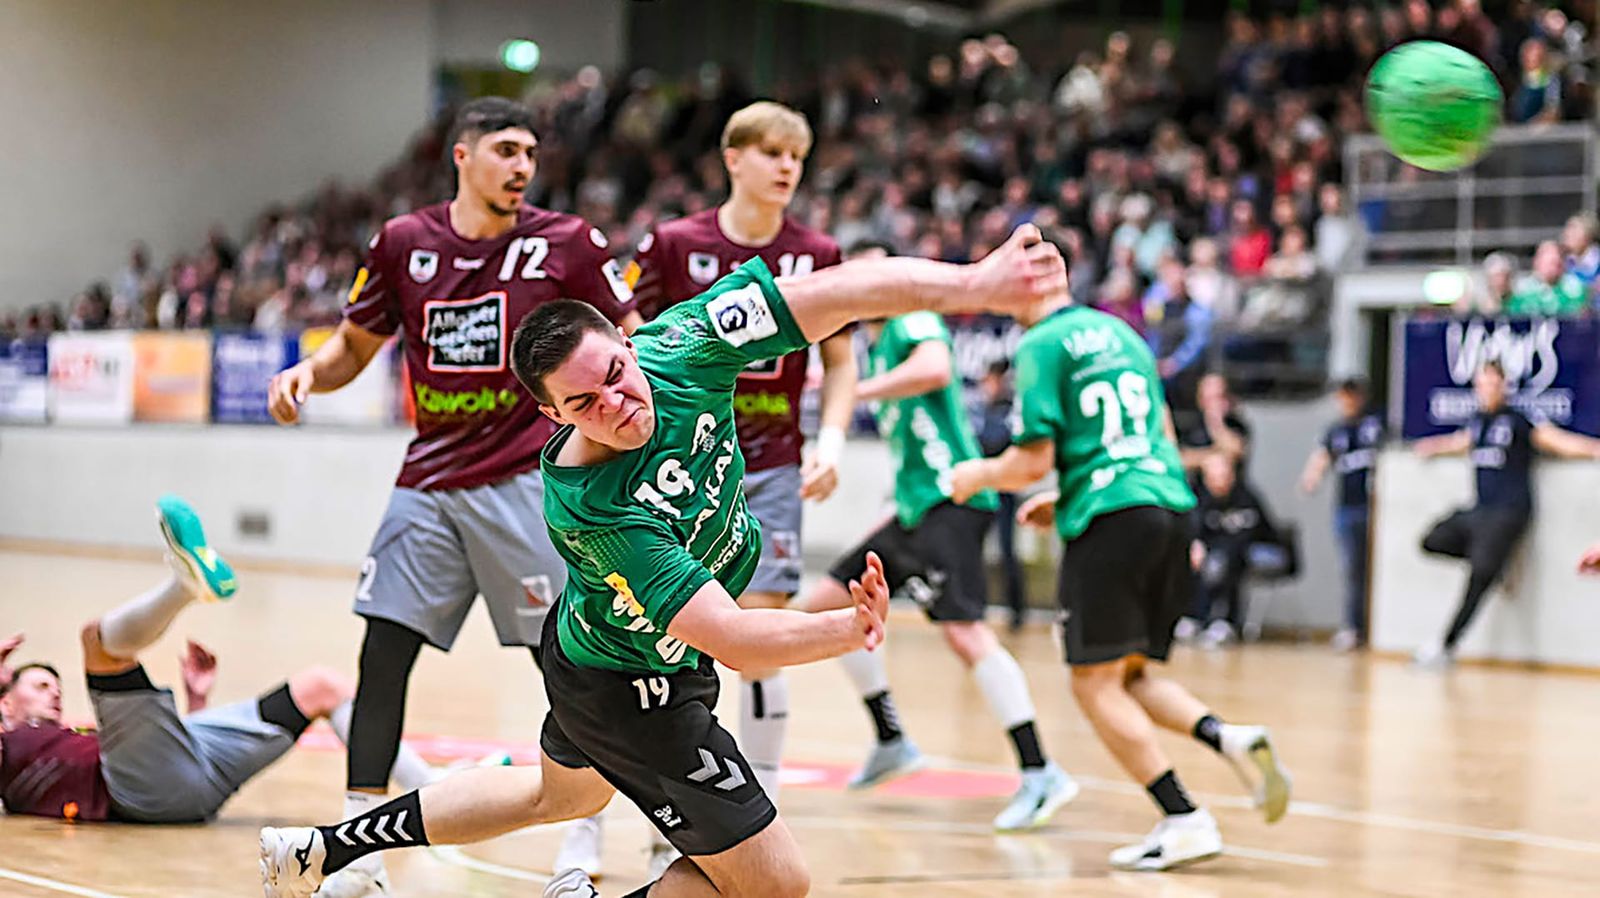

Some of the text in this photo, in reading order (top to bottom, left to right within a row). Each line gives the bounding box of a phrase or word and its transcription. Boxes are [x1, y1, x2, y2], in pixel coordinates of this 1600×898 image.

[498, 237, 548, 281] 12
[633, 458, 696, 519] 19
[632, 676, 670, 709] 19
